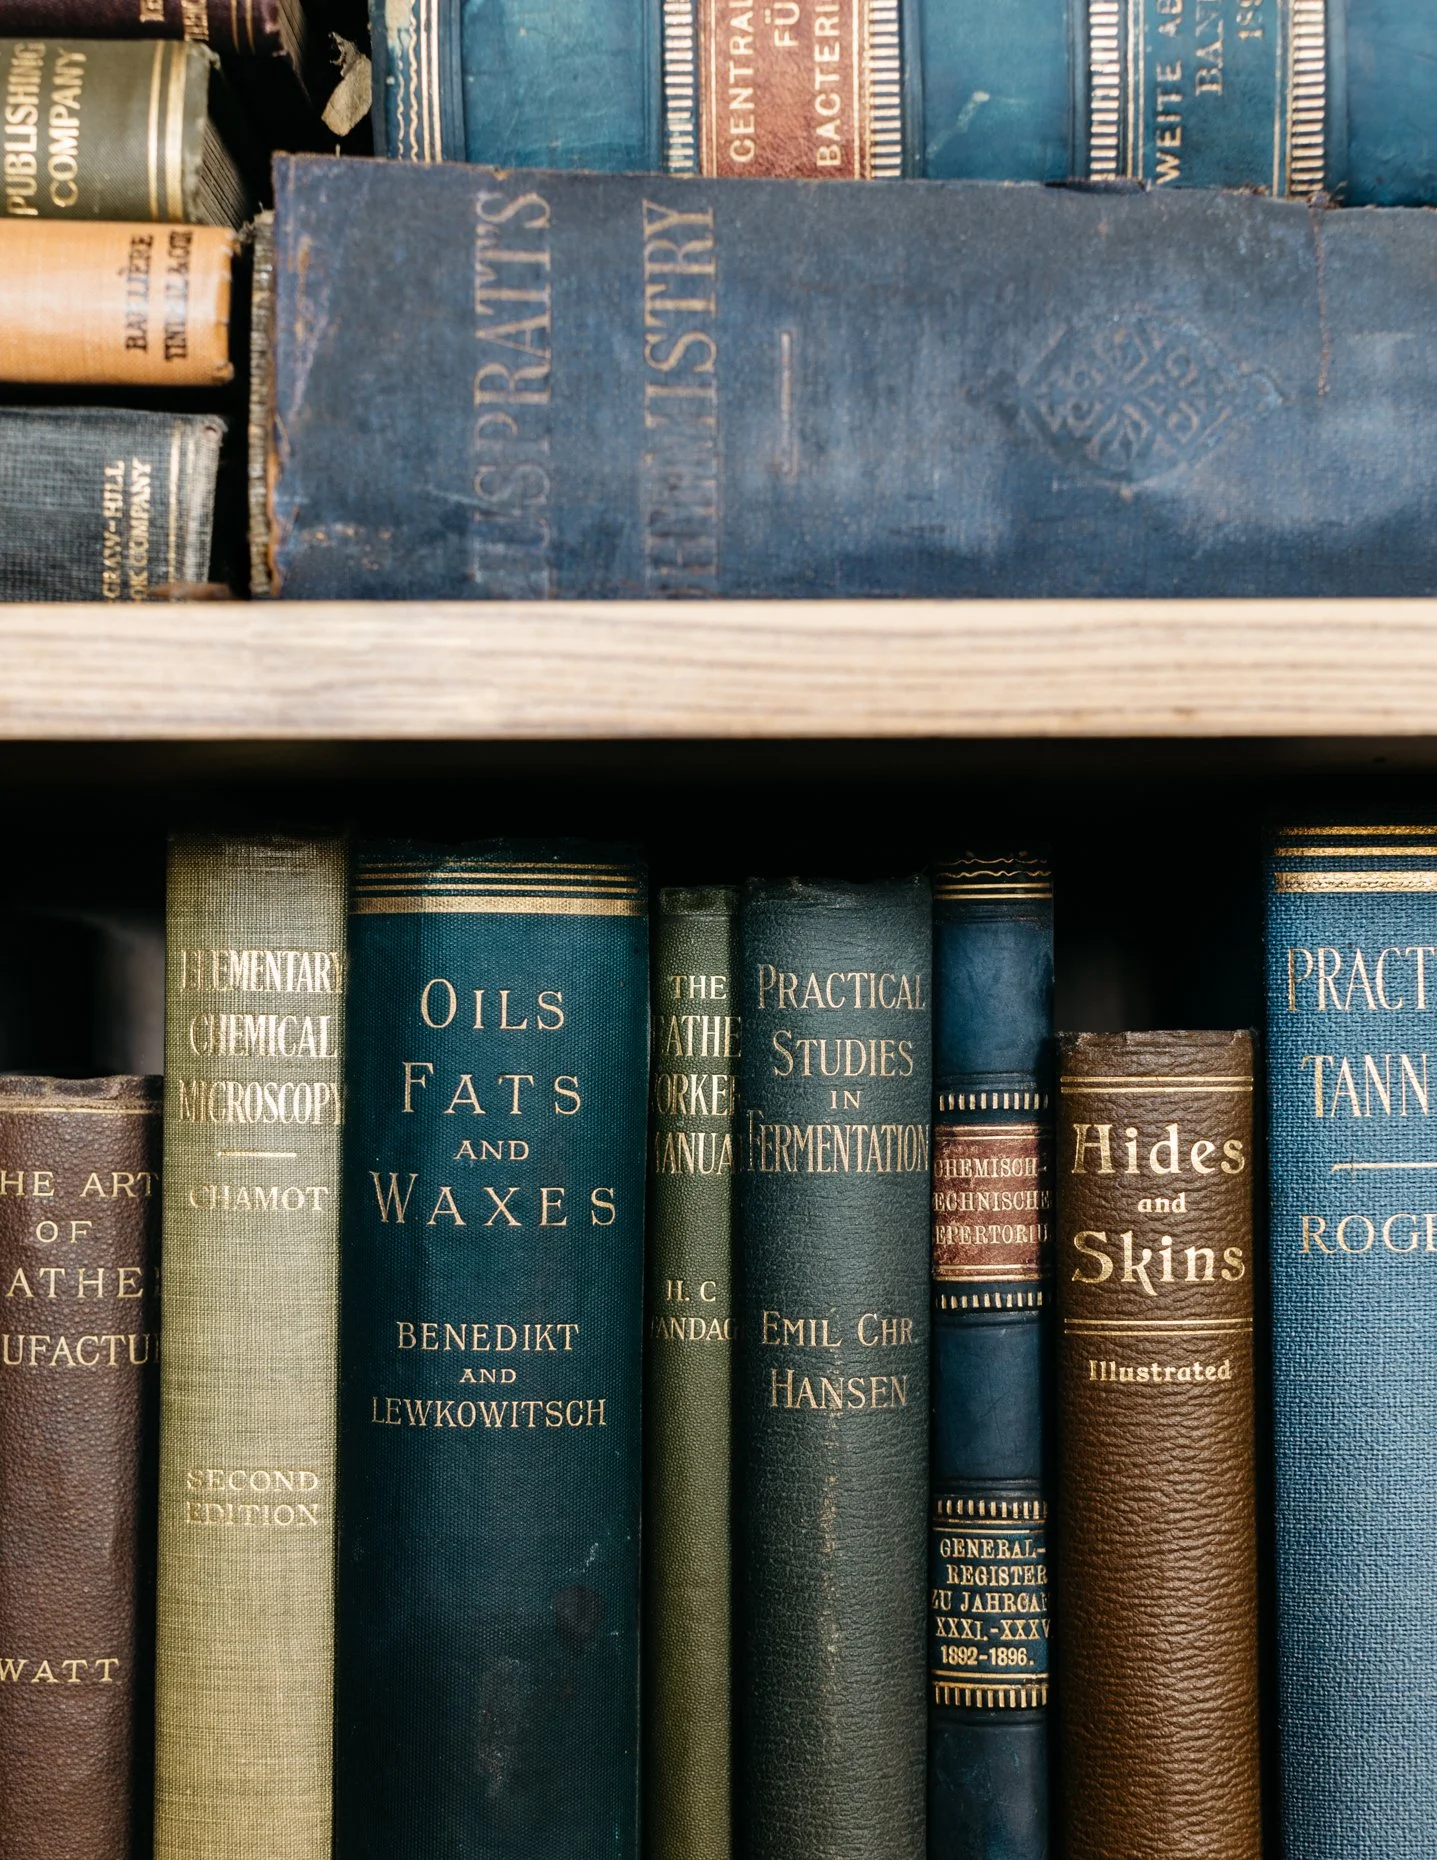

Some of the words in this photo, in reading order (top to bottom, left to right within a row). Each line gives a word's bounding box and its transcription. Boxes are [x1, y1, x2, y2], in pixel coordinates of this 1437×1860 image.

[1195, 0, 1224, 96] BAN
[4, 43, 46, 216] PUBLISHING
[48, 49, 86, 207] COMPANY
[129, 457, 151, 566] COMPANY
[670, 975, 727, 1000] THE
[757, 964, 926, 1010] PRACTICAL
[1286, 946, 1437, 1011] PRACT
[421, 978, 565, 1030] OILS
[190, 1014, 338, 1058] CHEMICAL
[772, 1029, 914, 1077] STUDIES
[401, 1062, 582, 1115] FATS
[830, 1090, 862, 1109] IN
[1301, 1053, 1429, 1118] TANN
[453, 1140, 529, 1160] AND
[655, 1131, 740, 1175] ANUA
[747, 1109, 929, 1173] FERMENTATION
[1071, 1123, 1245, 1174] Hides
[0, 1171, 55, 1196] HE
[80, 1172, 159, 1198] ART
[189, 1185, 329, 1211] CHAMOT
[369, 1171, 617, 1226] WAXES
[1138, 1192, 1187, 1213] and
[35, 1220, 93, 1244] OF
[1071, 1230, 1245, 1296] Skins
[5, 1267, 160, 1299] ATHE
[396, 1321, 579, 1351] BENEDIKT
[762, 1310, 843, 1347] EMIL
[2, 1334, 160, 1366] UFACTU
[460, 1368, 517, 1384] AND
[1089, 1360, 1232, 1383] Illustrated
[771, 1368, 907, 1410] HANSEN
[372, 1397, 607, 1428] LEWKOWITSCH
[186, 1468, 319, 1492] SECOND
[186, 1501, 319, 1526] EDITION
[940, 1538, 1046, 1559] GENERAL-
[946, 1564, 1048, 1586] REGISTER
[0, 1657, 120, 1683] WATT
[940, 1645, 1035, 1666] 1892-1896.
